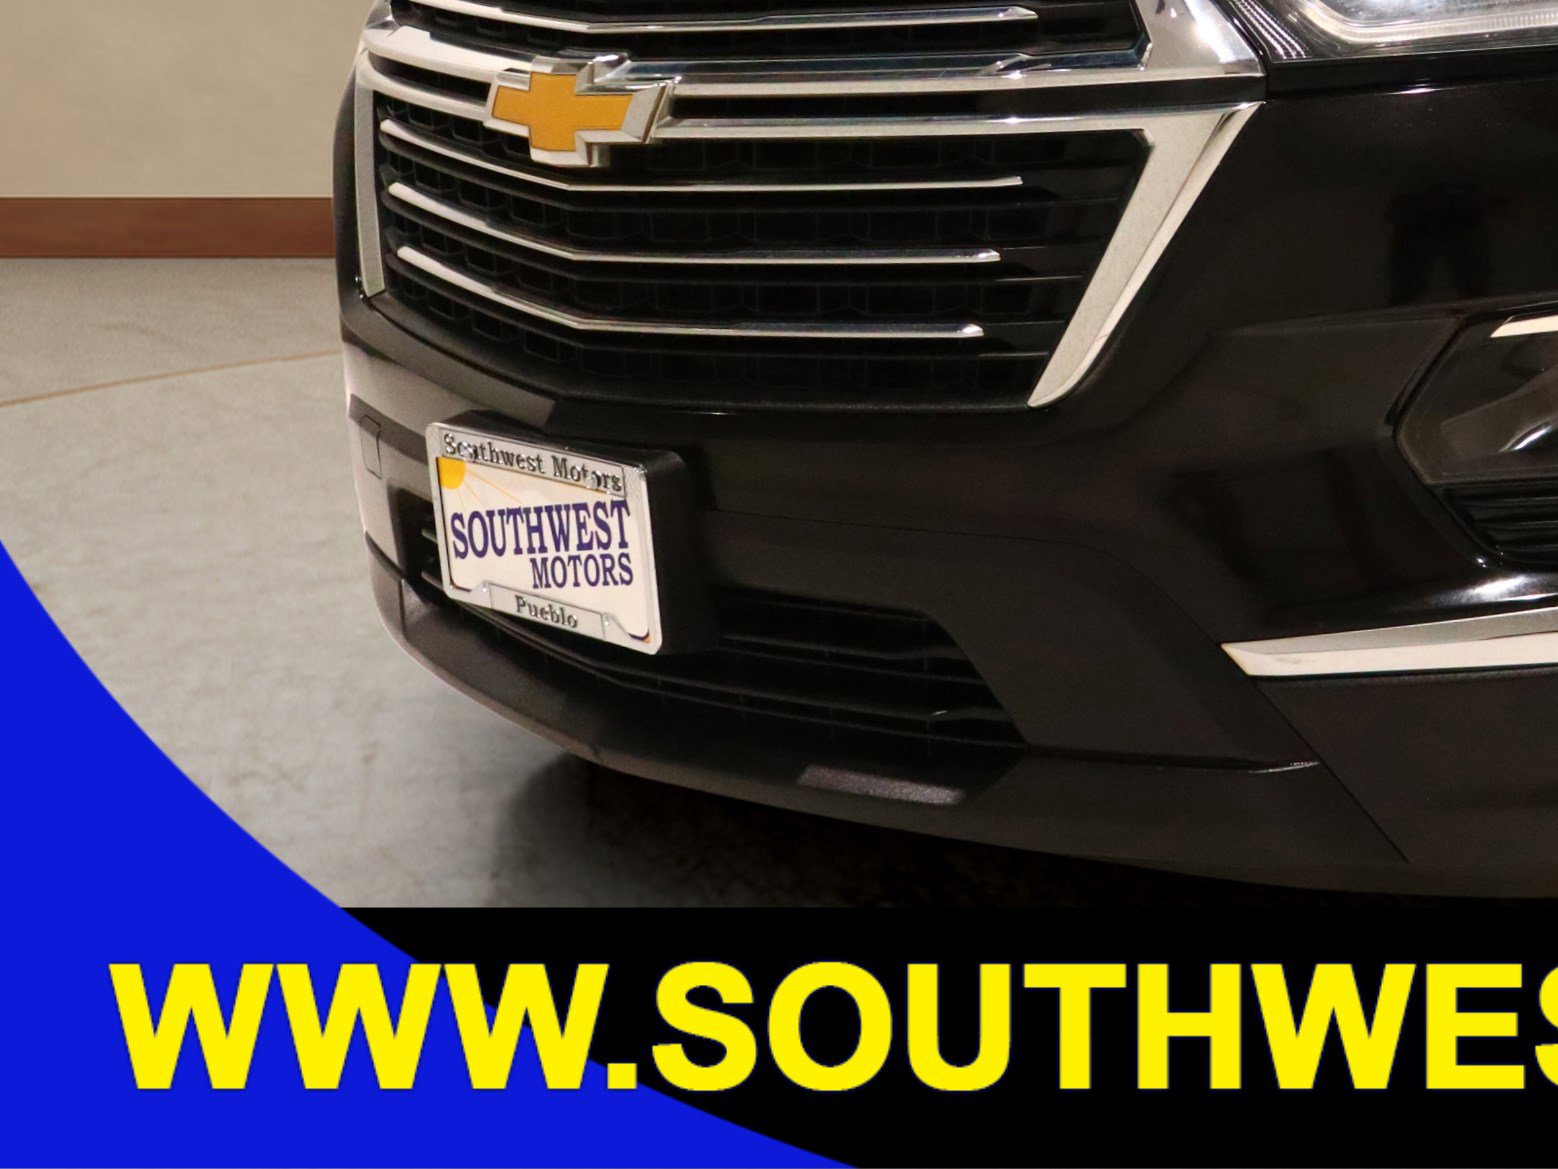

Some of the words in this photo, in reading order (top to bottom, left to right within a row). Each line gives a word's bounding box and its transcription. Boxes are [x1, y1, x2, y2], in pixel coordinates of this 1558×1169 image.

[444, 434, 546, 475] Southwest
[552, 454, 623, 492] Motors
[450, 499, 631, 560] SOUTHWEST
[529, 552, 634, 590] MOTORS
[514, 594, 578, 629] Pueblo
